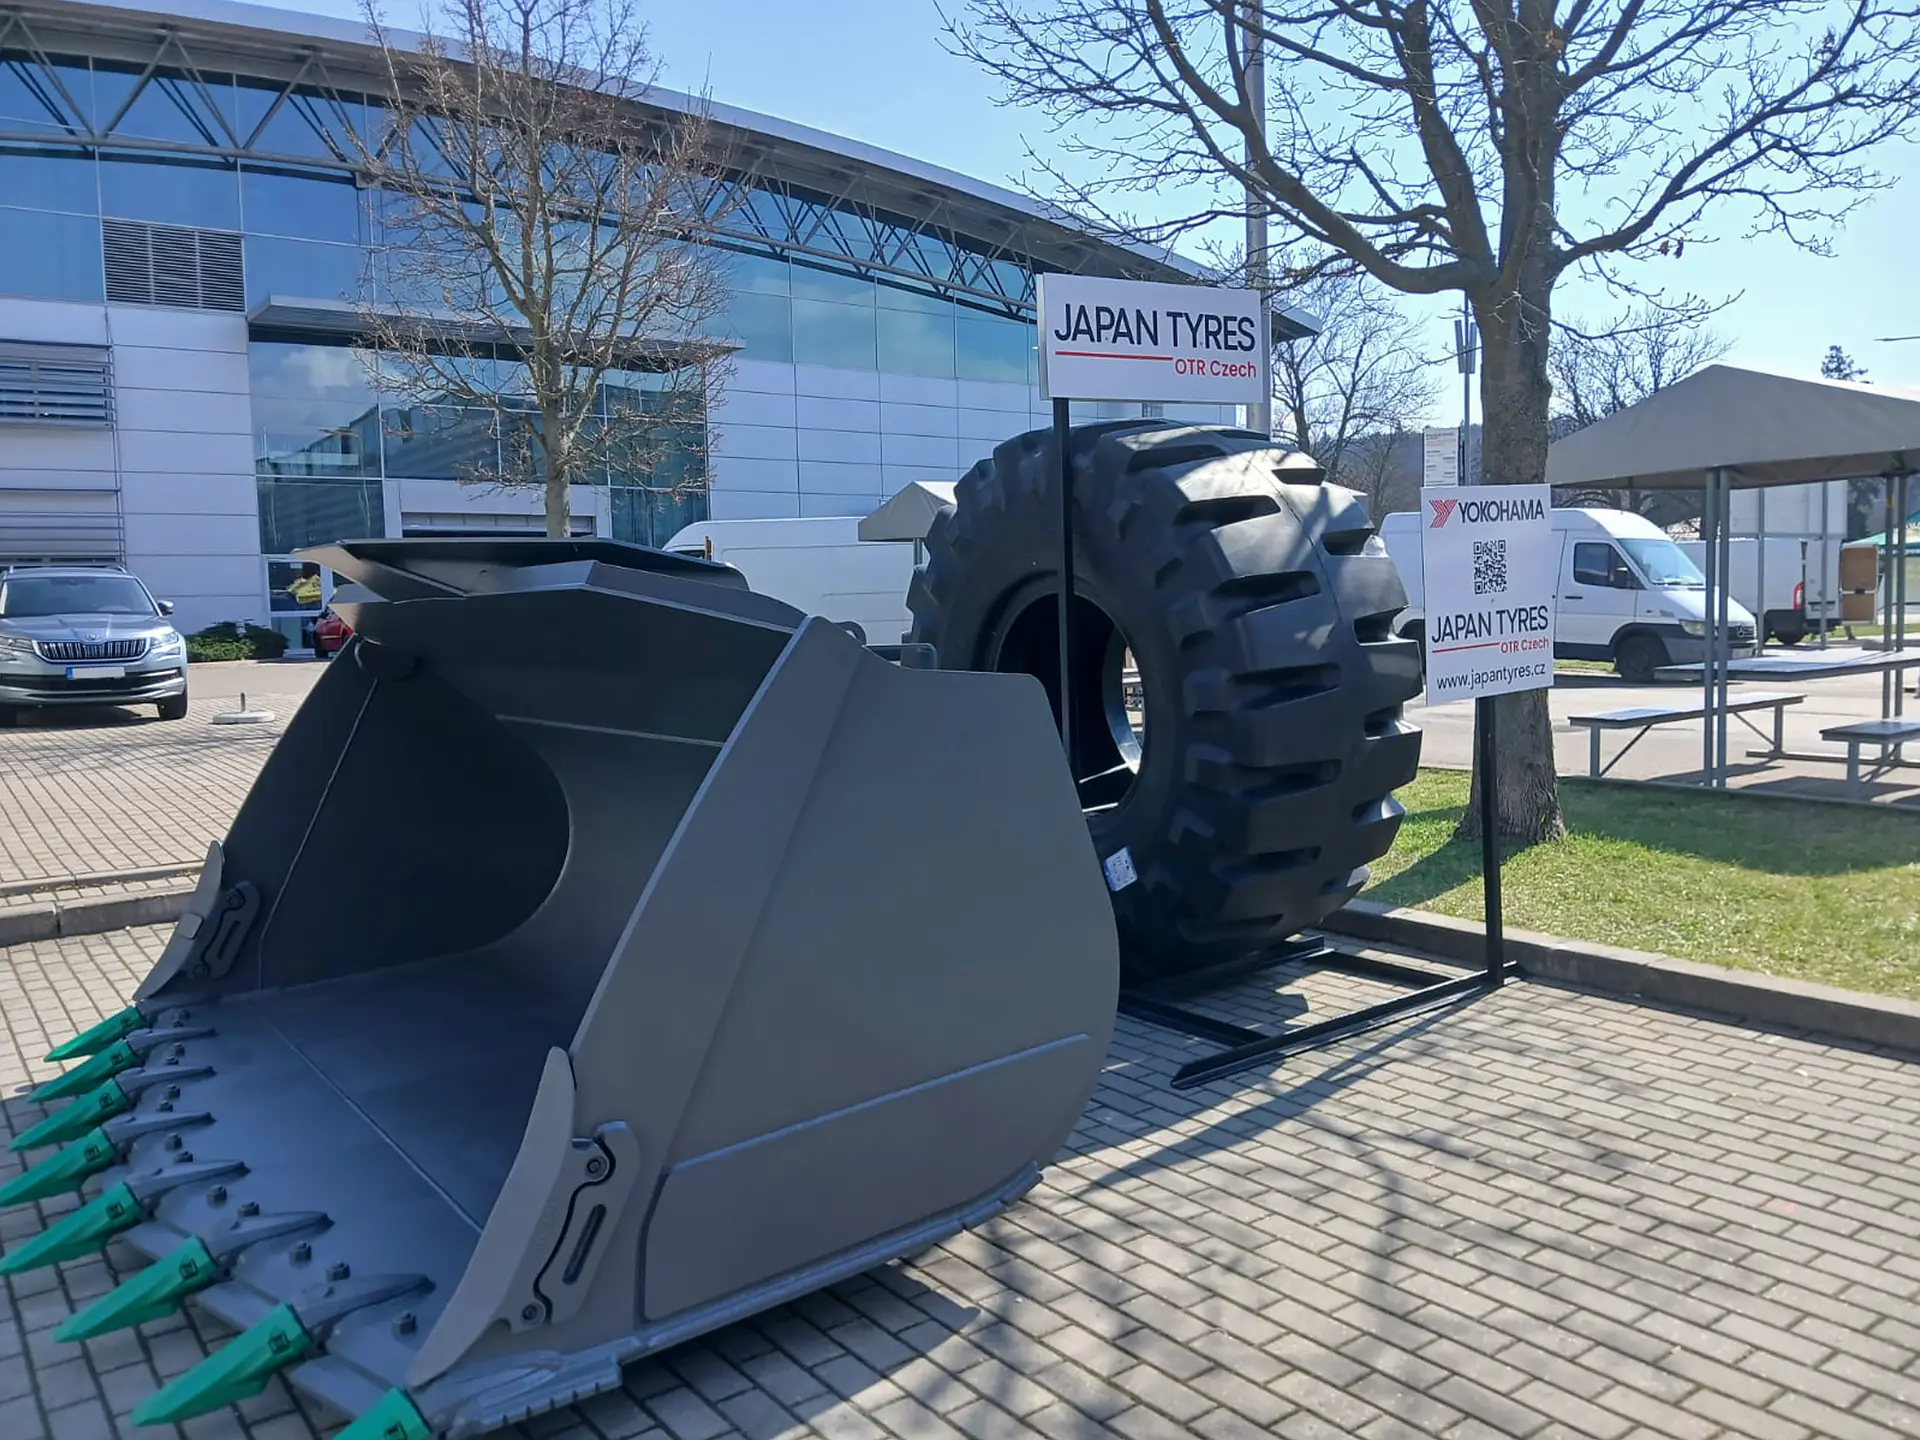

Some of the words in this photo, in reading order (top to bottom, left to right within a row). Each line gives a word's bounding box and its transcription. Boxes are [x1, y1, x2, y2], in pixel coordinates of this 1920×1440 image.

[1054, 303, 1159, 346] JAPAN
[1166, 311, 1256, 352] TYRES
[1174, 358, 1206, 376] OTR
[1210, 360, 1257, 378] Czech
[1458, 498, 1545, 523] YOKOHAMA
[1431, 611, 1492, 643] JAPAN
[1496, 605, 1549, 635] TYRES
[1500, 640, 1520, 653] OTR
[1521, 636, 1549, 651] Czech
[1436, 663, 1546, 690] www.japantyres.cz
